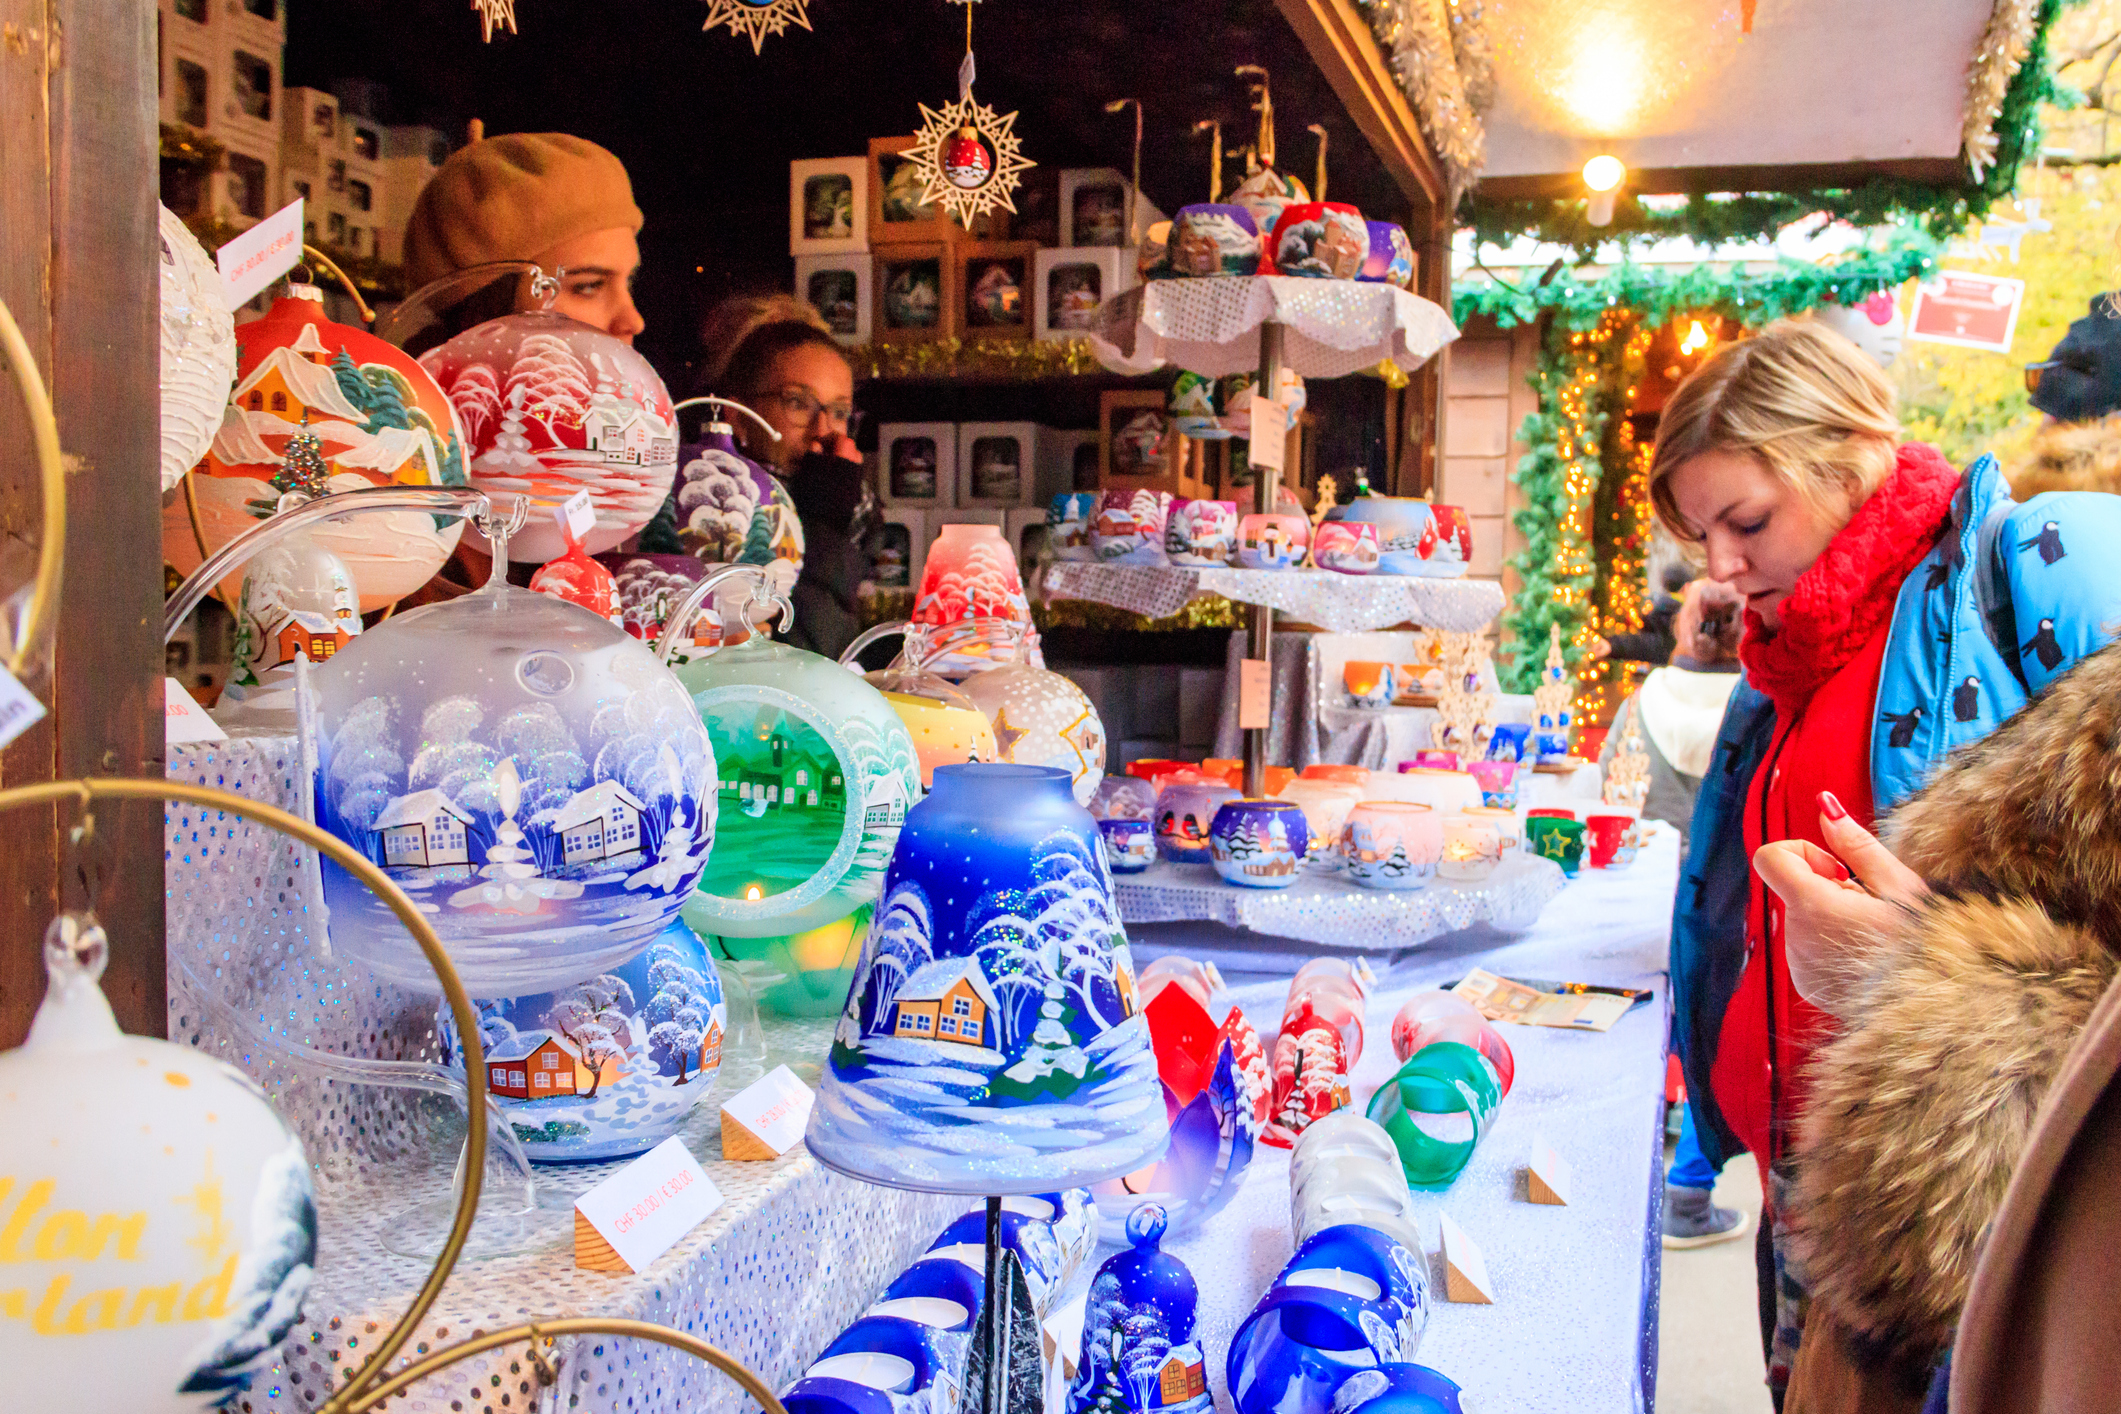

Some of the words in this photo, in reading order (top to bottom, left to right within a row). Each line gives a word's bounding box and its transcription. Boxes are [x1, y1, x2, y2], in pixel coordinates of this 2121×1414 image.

[754, 1113, 771, 1129] CHF
[0, 1175, 148, 1264] lon
[614, 1211, 636, 1234] CHF
[631, 1194, 661, 1221] 30.00
[655, 1188, 666, 1206] /
[661, 1185, 673, 1198] €
[667, 1169, 694, 1194] 30.00
